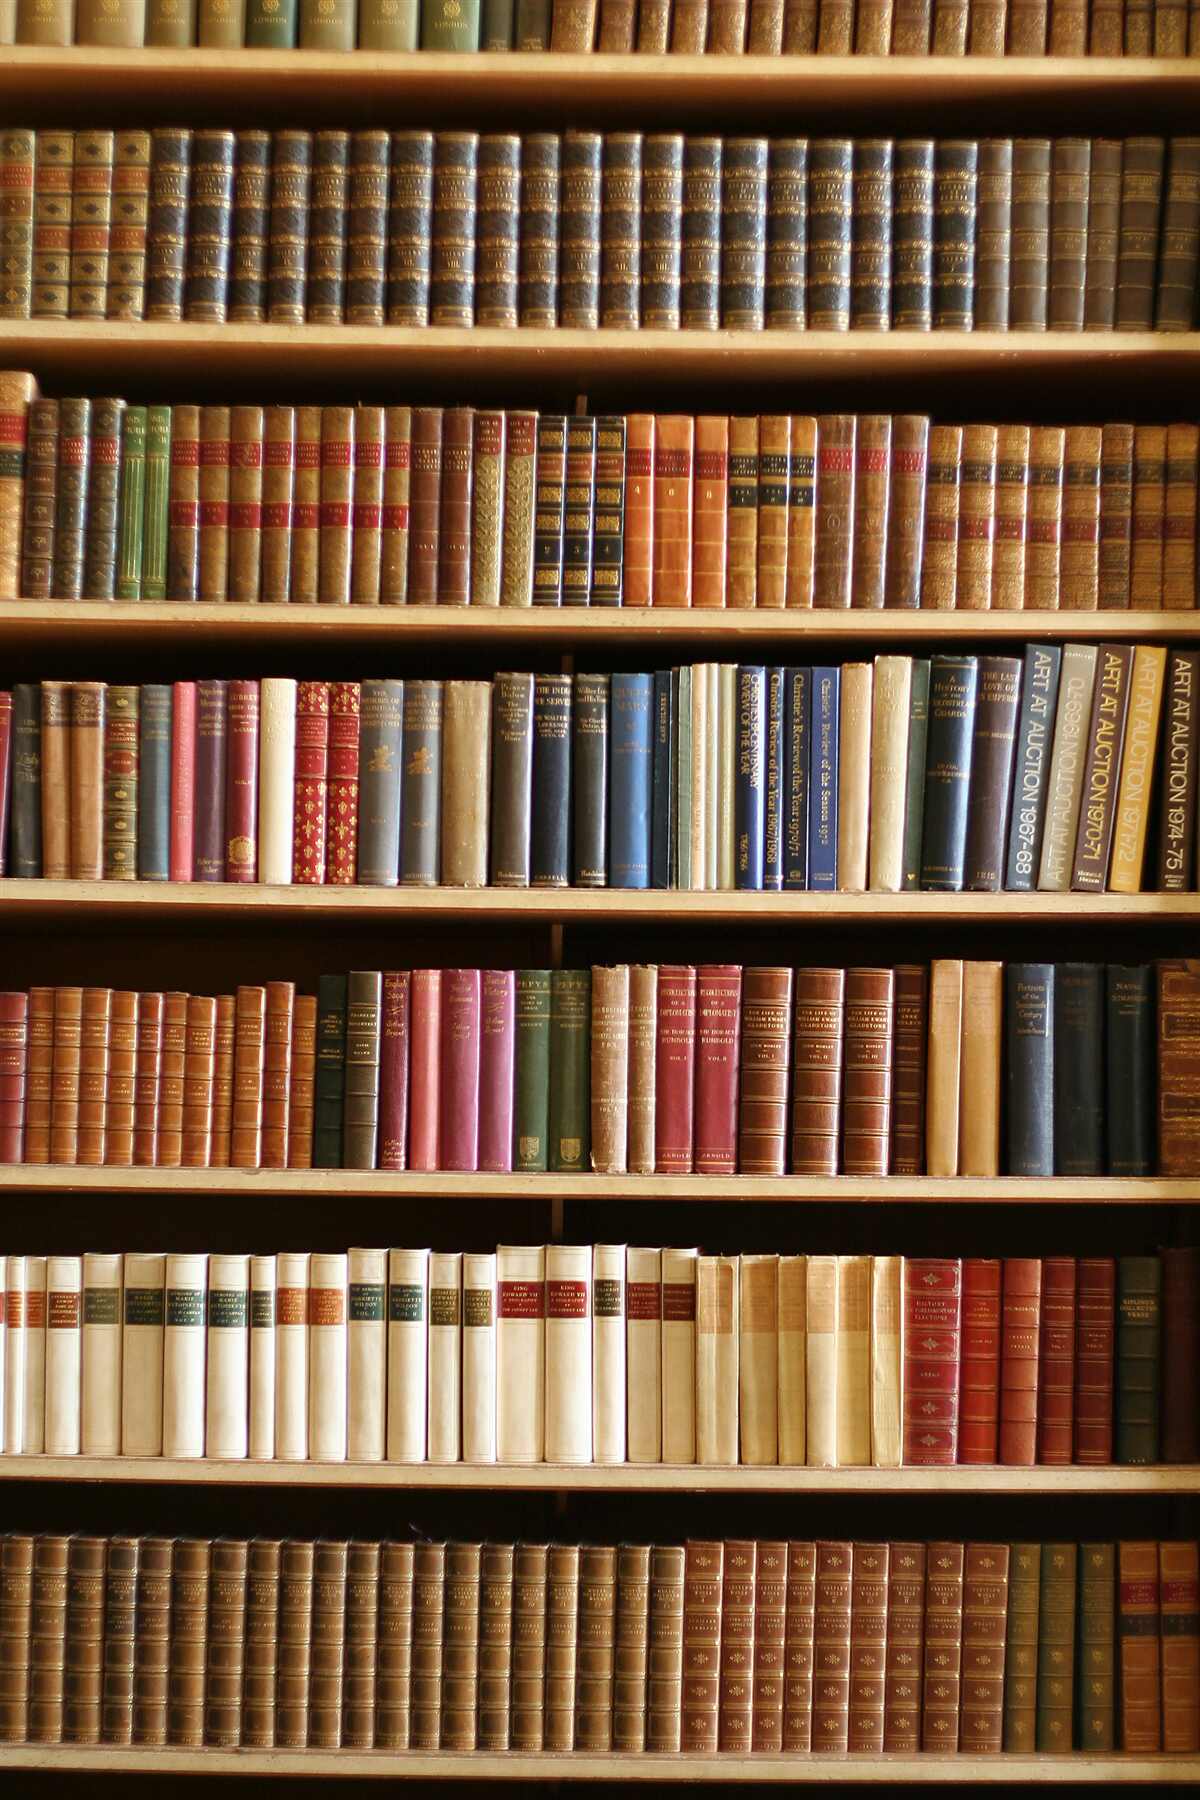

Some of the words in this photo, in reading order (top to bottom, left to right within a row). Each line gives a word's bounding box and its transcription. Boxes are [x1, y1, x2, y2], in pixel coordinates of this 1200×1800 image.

[1032, 651, 1051, 688] ART
[1102, 652, 1122, 693] ART
[1138, 655, 1158, 695] ART
[1173, 658, 1192, 697] ART
[741, 674, 750, 713] REVIEW
[792, 674, 804, 723] Christie's
[820, 678, 832, 719] Christie's
[1031, 694, 1047, 718] AT
[1064, 677, 1086, 740] 1969-70
[1099, 694, 1118, 717] AT
[1134, 694, 1152, 717] AT
[1172, 699, 1190, 721] AT
[741, 714, 750, 729] OF
[768, 721, 779, 756] Review
[740, 730, 750, 749] THE
[792, 725, 802, 764] Review
[821, 723, 830, 756] Review
[740, 749, 750, 774] YEAR
[768, 758, 779, 770] of
[792, 764, 803, 776] of
[821, 759, 832, 771] of
[1022, 720, 1044, 801] AUCTION
[1089, 719, 1114, 802] AUCTION
[1126, 719, 1150, 801] AUCTION
[1170, 722, 1188, 802] AUCTION
[768, 772, 778, 787] the
[791, 776, 802, 793] the
[821, 772, 830, 787] the
[1056, 741, 1080, 823] AUCTION
[767, 789, 778, 812] Year
[791, 794, 802, 818] Year
[821, 790, 830, 821] Season
[766, 813, 777, 863] 1967/1968
[787, 818, 800, 856] 1970/71
[1014, 806, 1036, 874] 1967-68
[1053, 825, 1070, 849] AT
[1083, 804, 1105, 860] 1970-71
[1118, 806, 1140, 862] 1971-72
[1166, 806, 1184, 870] 1974-75
[1047, 850, 1066, 884] ART
[385, 979, 407, 988] English
[1018, 1010, 1043, 1020] Century
